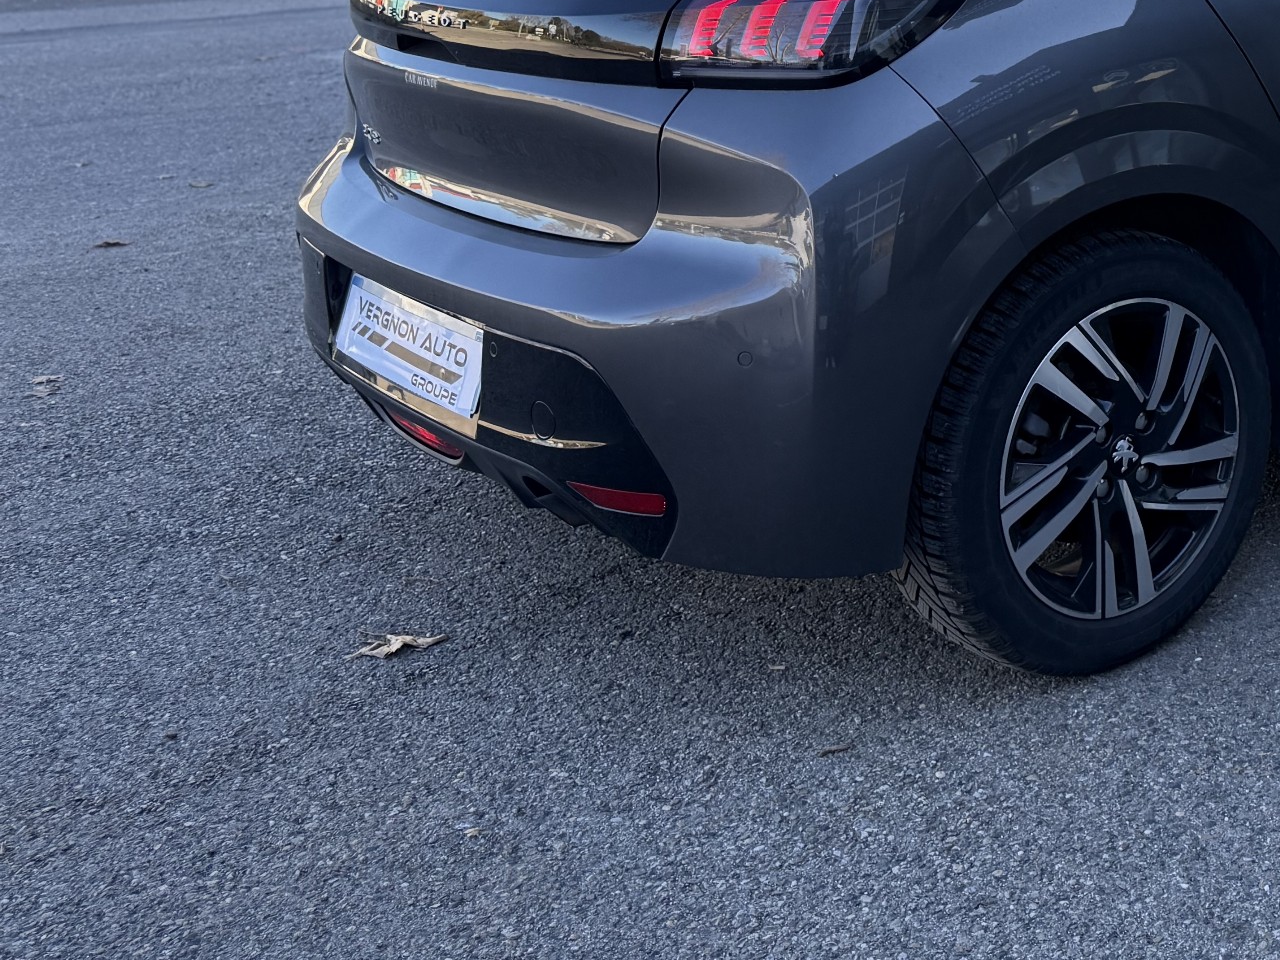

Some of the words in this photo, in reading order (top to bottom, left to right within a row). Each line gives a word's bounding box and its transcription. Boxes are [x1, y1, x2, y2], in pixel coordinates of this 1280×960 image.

[376, 4, 468, 29] PEUGEOT
[359, 295, 420, 345] VERGNON
[420, 332, 468, 368] AUTO
[410, 373, 458, 406] GROUPE
